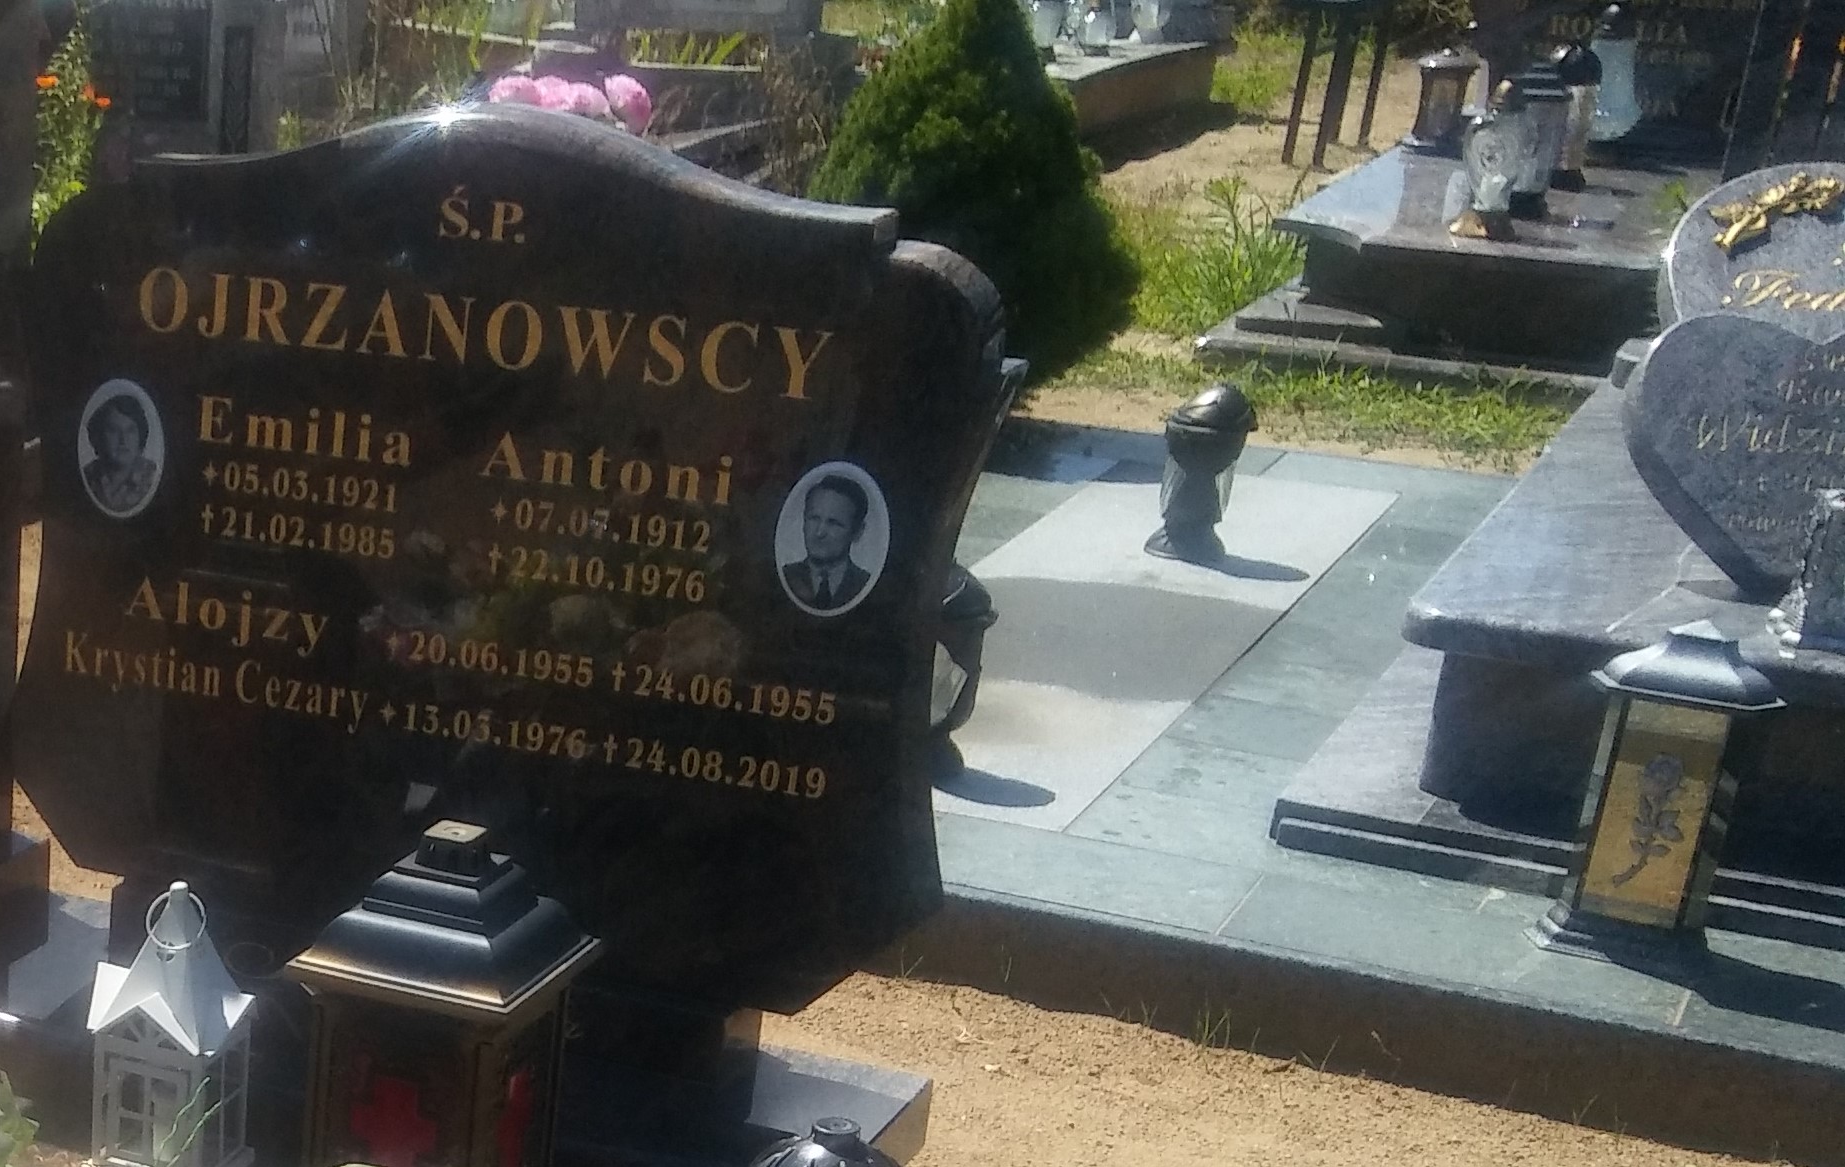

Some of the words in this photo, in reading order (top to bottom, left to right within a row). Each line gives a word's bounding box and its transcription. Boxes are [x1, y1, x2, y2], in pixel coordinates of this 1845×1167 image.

[438, 187, 526, 245] Ś.P.
[138, 266, 834, 400] OJRZANOWSCY
[197, 394, 412, 468] Emilia
[223, 461, 398, 514] 05.03.1921
[478, 431, 734, 506] Antoni
[220, 506, 396, 560] 21.02.1985
[510, 546, 706, 603] 22.10.1976
[123, 575, 330, 658] Alojzy
[407, 631, 594, 688] 20.06.1955
[632, 664, 837, 726] 24.06.1955
[62, 629, 223, 699] Krystian
[234, 658, 372, 735] Cezary
[626, 737, 827, 800] 24.08.2019
